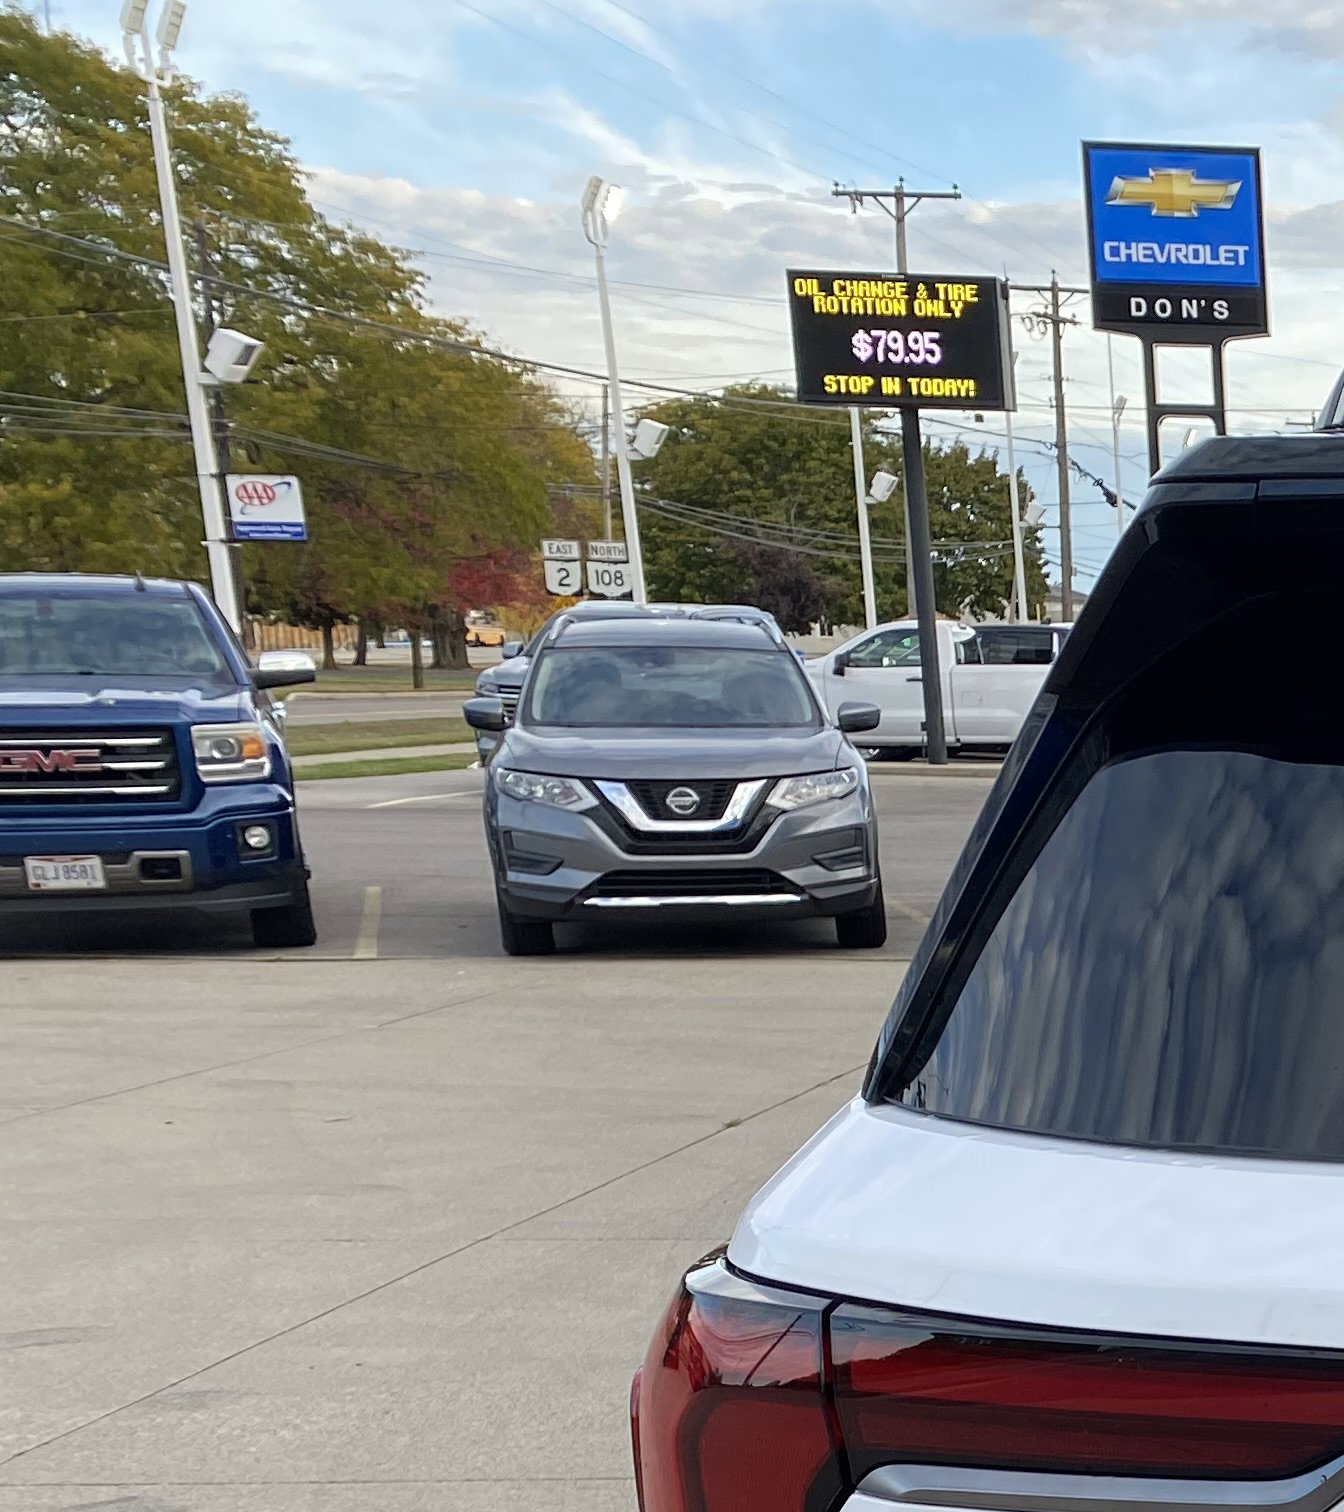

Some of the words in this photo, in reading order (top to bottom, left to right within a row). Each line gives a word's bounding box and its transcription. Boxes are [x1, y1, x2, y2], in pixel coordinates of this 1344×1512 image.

[1103, 241, 1249, 266] CHEVROLET
[794, 278, 826, 297] OIL
[833, 279, 908, 299] CHANGE
[915, 283, 928, 299] &
[935, 283, 978, 302] TIRE
[813, 296, 906, 316] ROTATION
[913, 299, 963, 318] ONLY
[1130, 297, 1230, 320] DON'S
[851, 329, 941, 364] $79.95
[823, 375, 874, 395] STOP
[881, 376, 900, 396] IN
[908, 377, 976, 397] TODAY!
[240, 483, 273, 505] AAA
[548, 543, 572, 554] EAST
[591, 545, 624, 556] NORTH
[557, 567, 571, 587] 2
[595, 569, 624, 587] 108
[0, 749, 101, 772] GMC
